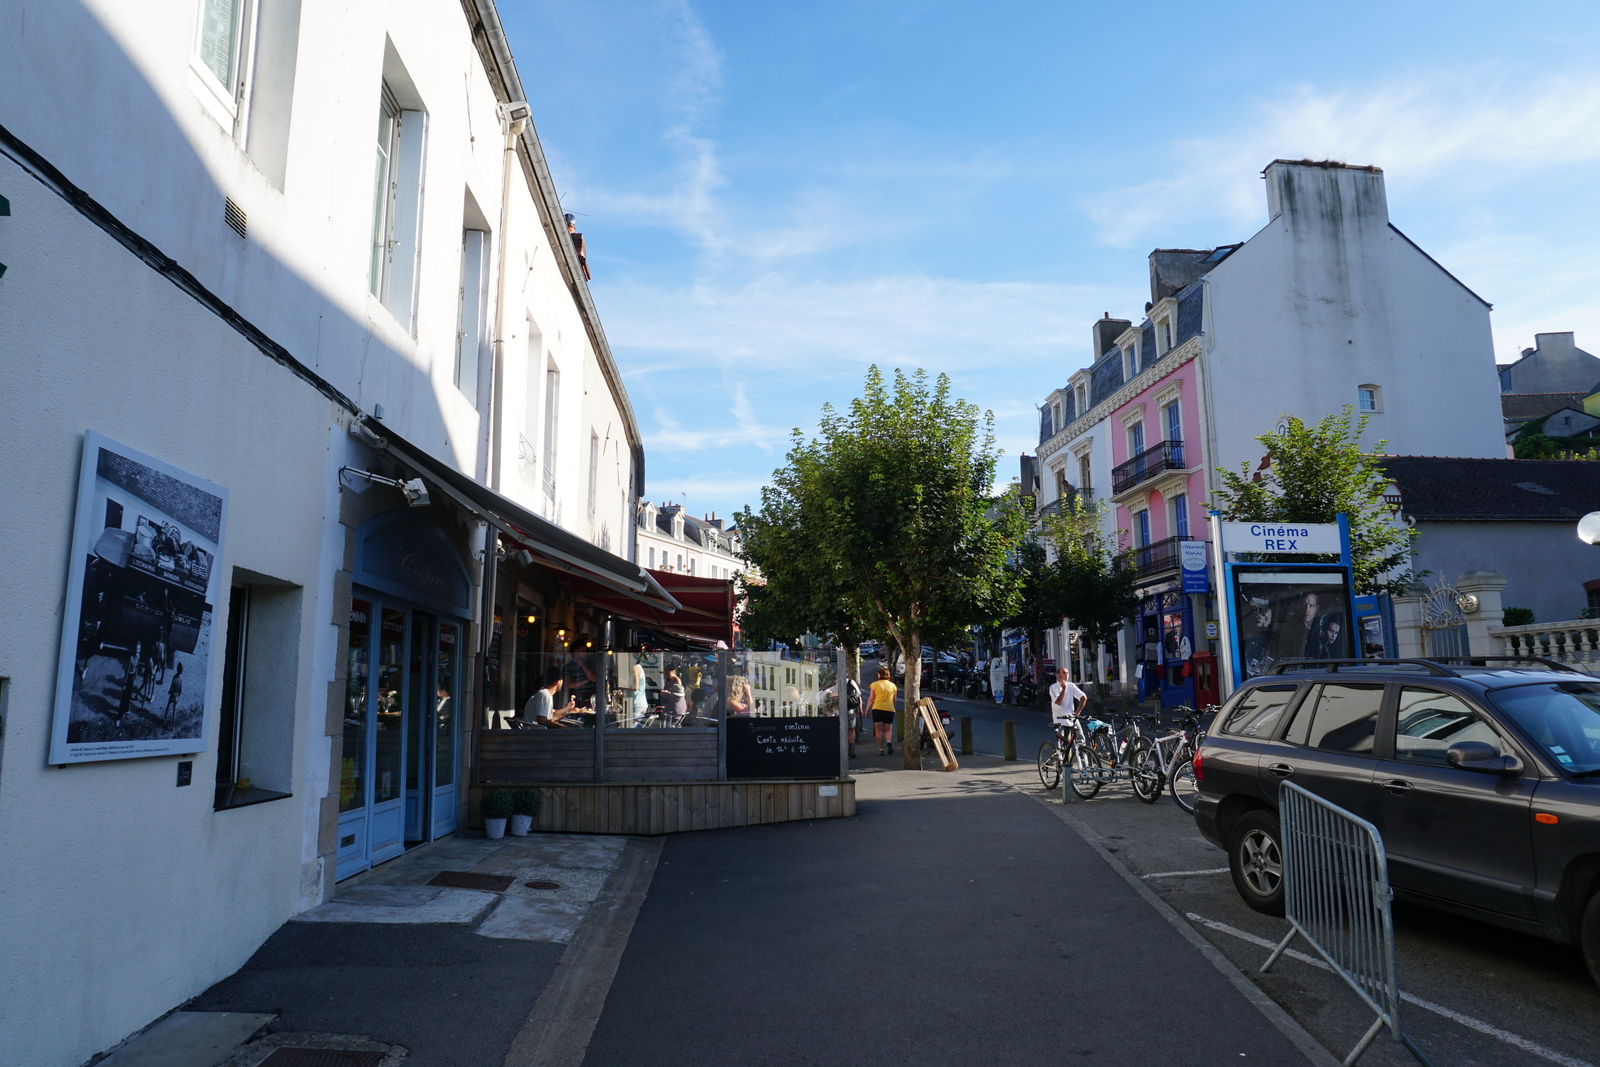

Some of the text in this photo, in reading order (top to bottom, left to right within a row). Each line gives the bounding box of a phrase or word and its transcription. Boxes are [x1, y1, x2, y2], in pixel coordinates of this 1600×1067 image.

[1250, 525, 1309, 537] Cinéma
[1264, 540, 1298, 550] REX
[399, 546, 446, 588] Coiffure
[135, 602, 164, 617] SERVICE
[1355, 602, 1375, 612] ritime
[749, 722, 811, 733] Service continu
[757, 735, 805, 744] Carte réduite
